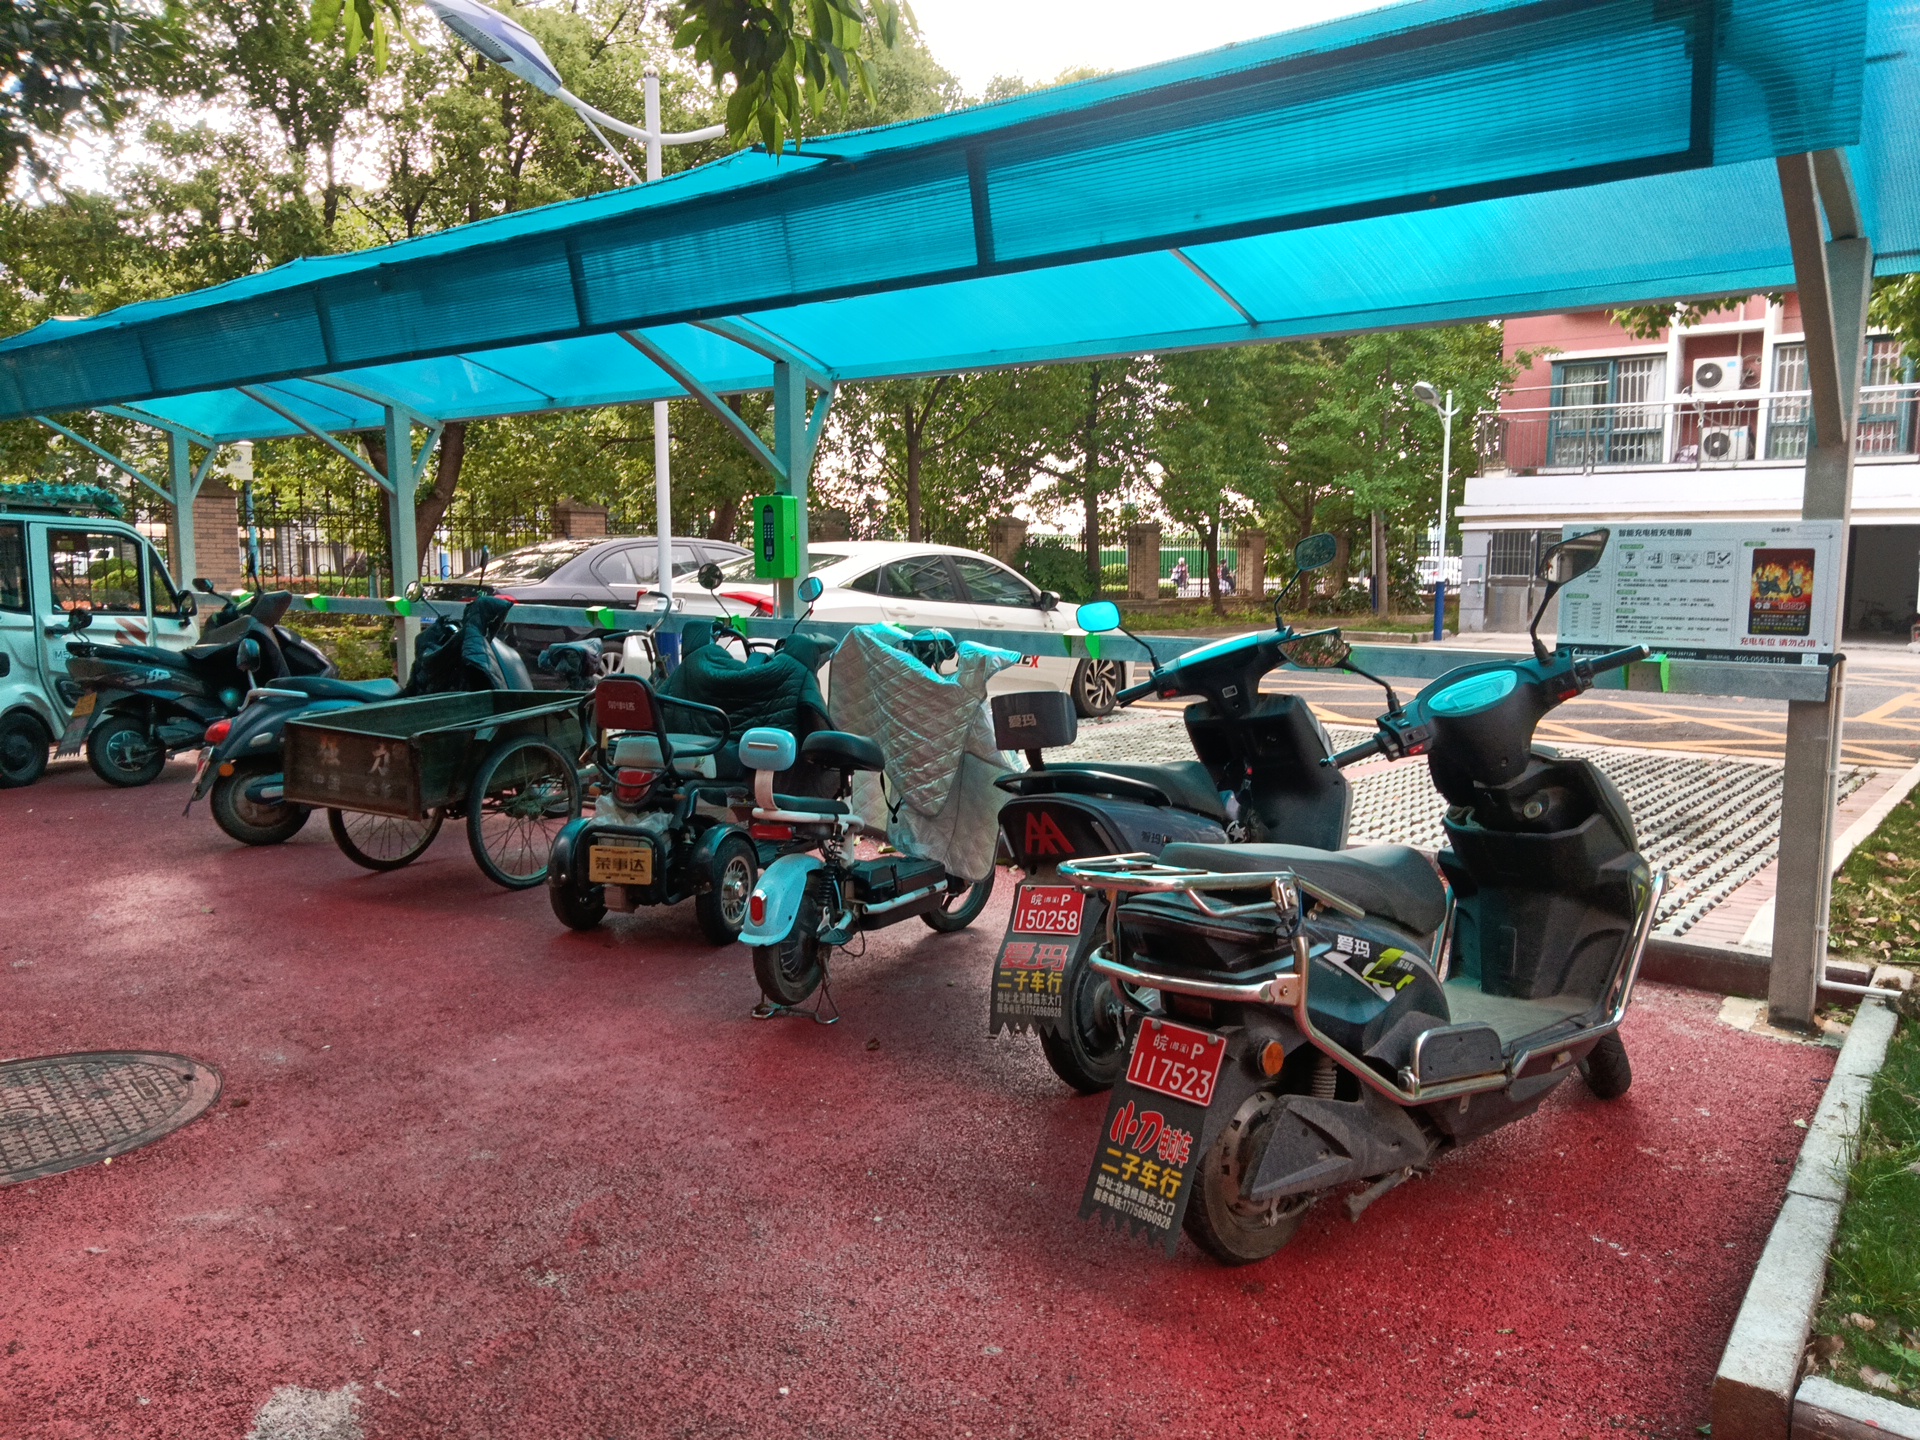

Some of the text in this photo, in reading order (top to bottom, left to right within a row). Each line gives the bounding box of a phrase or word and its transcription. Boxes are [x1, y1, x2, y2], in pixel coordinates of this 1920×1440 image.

[1618, 528, 1692, 537] 智能充电桩充电指南
[1740, 637, 1816, 648] 充电车位 请勿占用
[1008, 713, 1037, 728] 爱玛
[596, 856, 645, 872] 荣事达
[1018, 909, 1078, 931] 150258
[1336, 933, 1371, 958] 爱玛
[1000, 942, 1069, 972] 爱玛
[998, 970, 1063, 993] 二子车行
[1134, 1051, 1213, 1099] 117523
[1101, 1147, 1183, 1199] 二子车行
